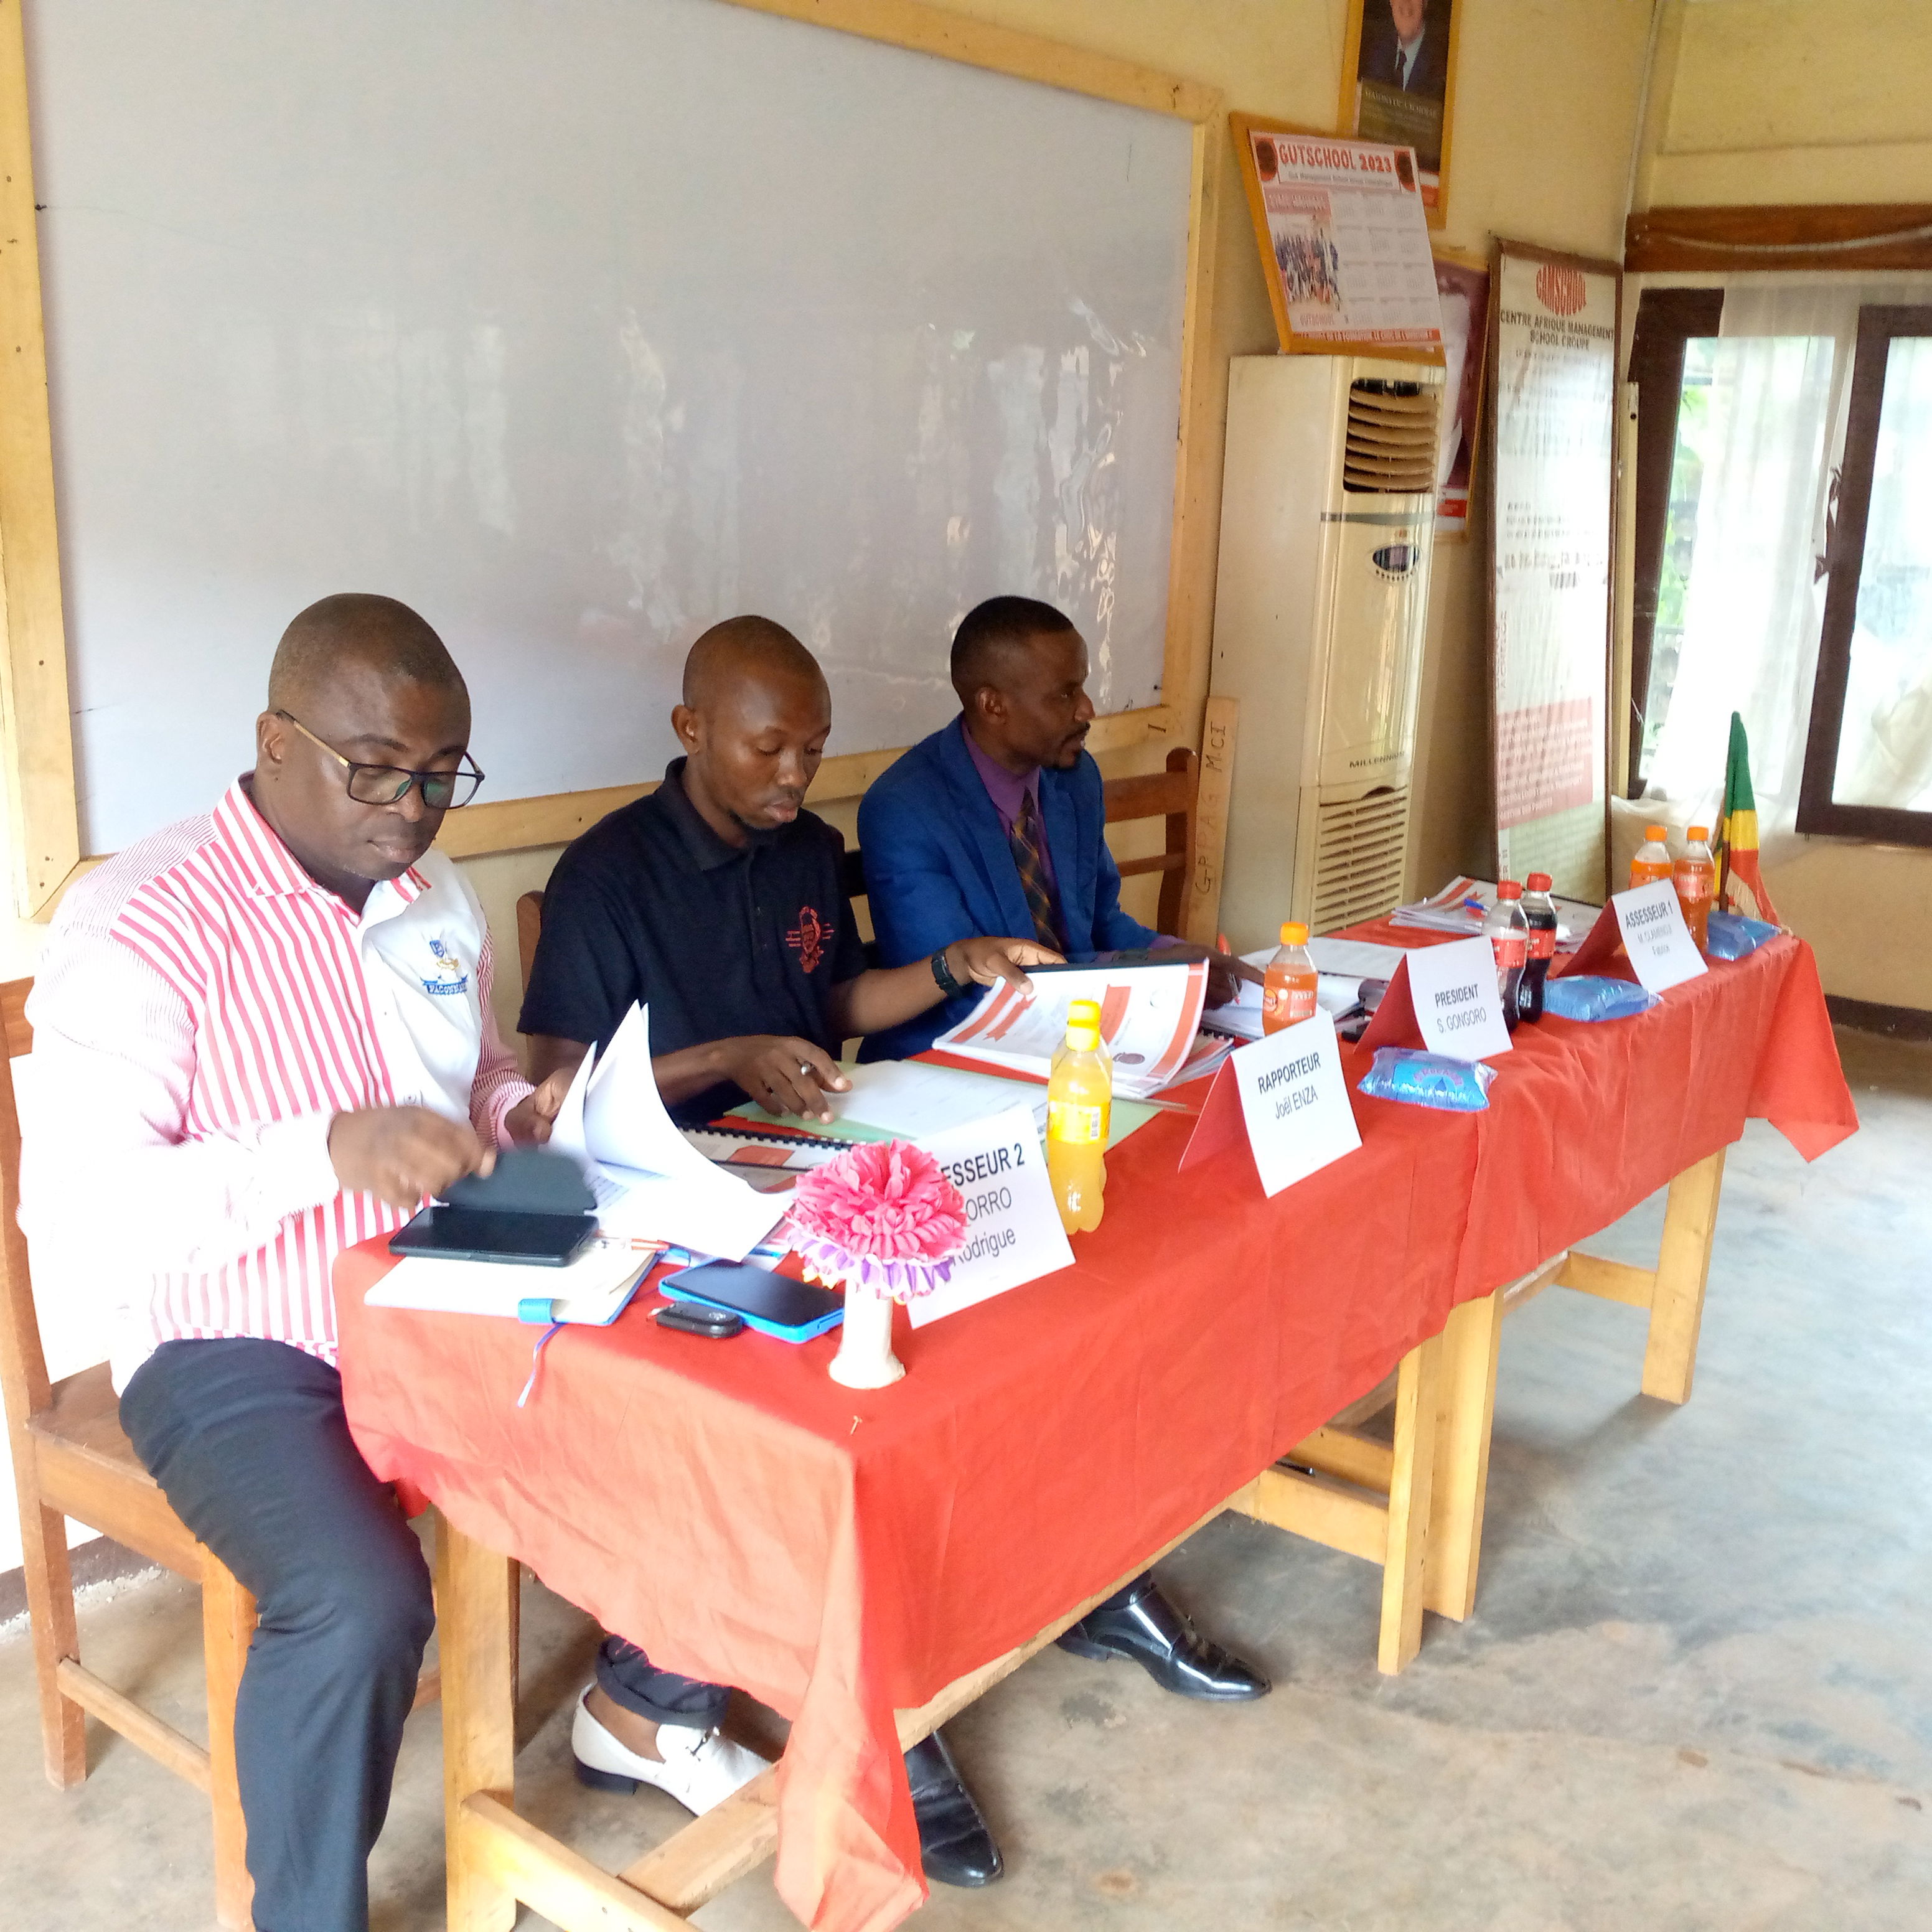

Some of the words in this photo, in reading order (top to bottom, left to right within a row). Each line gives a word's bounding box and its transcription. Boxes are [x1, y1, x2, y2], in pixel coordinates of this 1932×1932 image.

[1279, 144, 1356, 170] GUTSCHOOL
[1359, 153, 1392, 172] 2023
[1500, 309, 1532, 327] CENTRE
[1534, 314, 1566, 333] AFRIQUE
[1567, 320, 1615, 341] MANAGEMENT
[1530, 329, 1559, 346] SCHOOL
[1625, 901, 1669, 931] ASSESSEUR
[1667, 899, 1674, 915] 1
[1435, 983, 1478, 1008] PRESIDENT
[1437, 1018, 1447, 1034] S.
[1446, 1006, 1487, 1031] GONGORO
[1258, 1052, 1321, 1095] RAPPORTEUR
[1275, 1095, 1293, 1120] Joël
[1292, 1084, 1318, 1111] ENZA
[940, 1147, 1011, 1186] ESSEUR
[1014, 1143, 1025, 1167] 2
[965, 1186, 1012, 1221] ORRO
[953, 1228, 1016, 1266] odrigue
